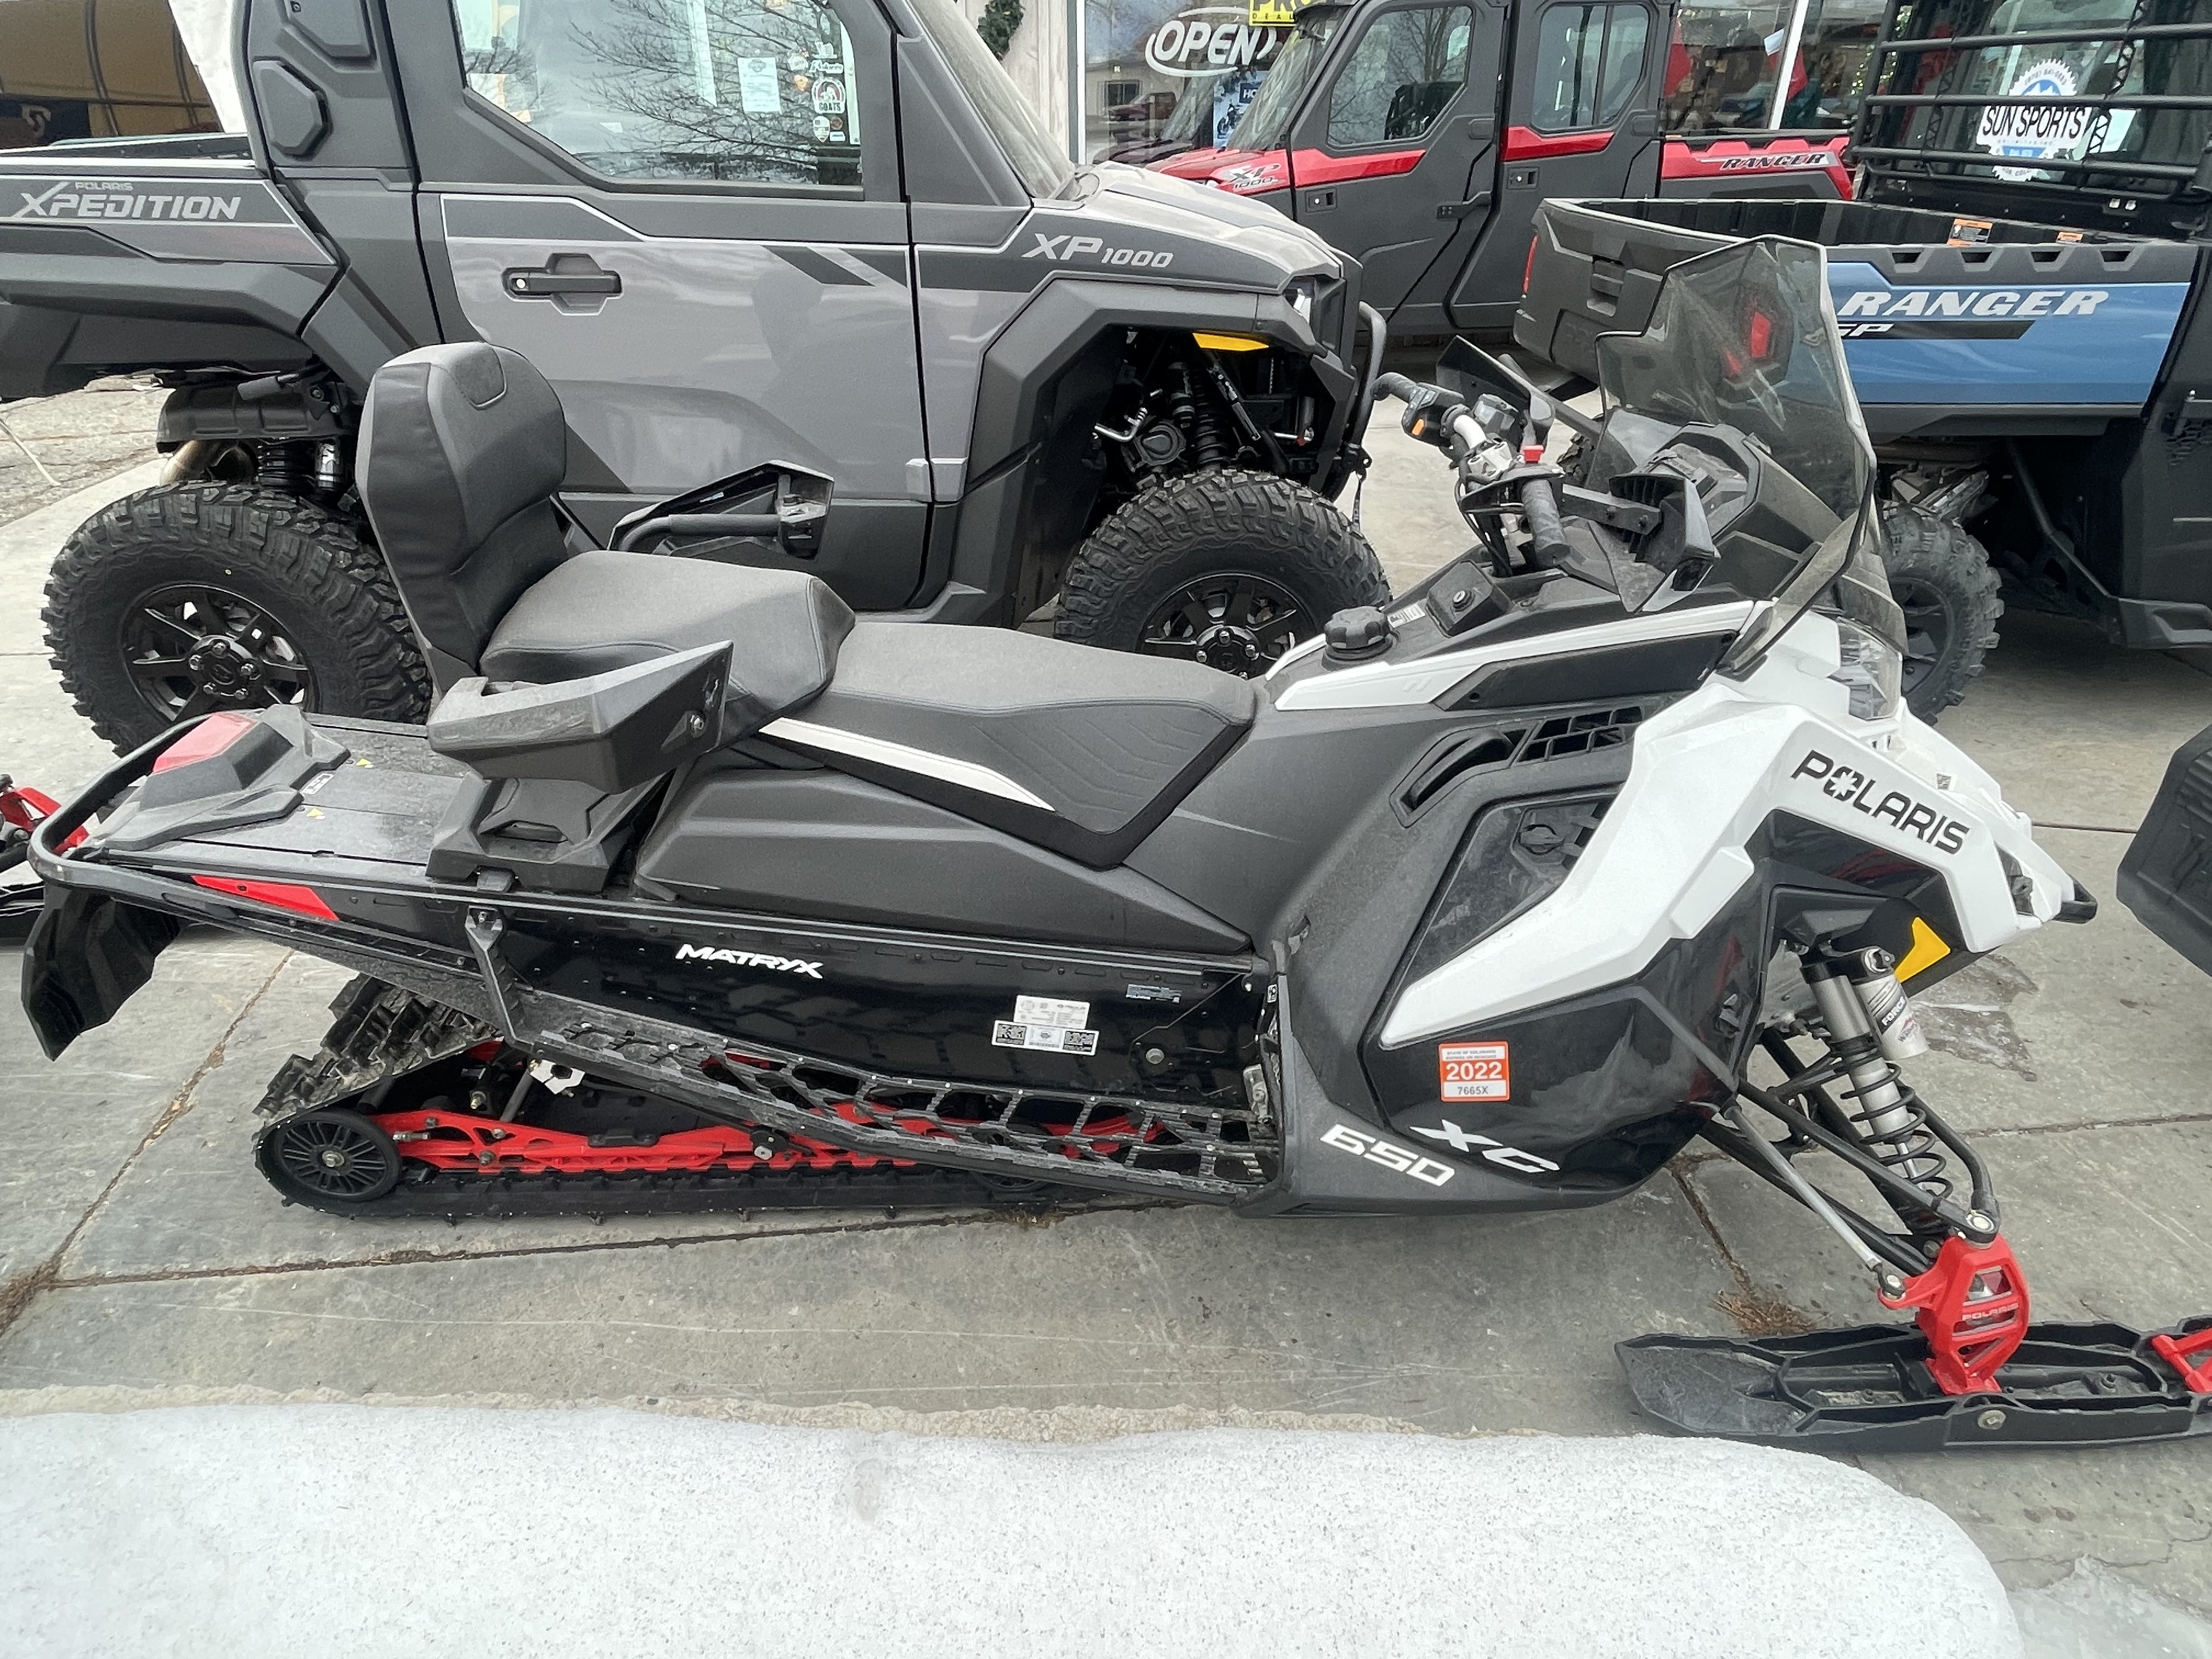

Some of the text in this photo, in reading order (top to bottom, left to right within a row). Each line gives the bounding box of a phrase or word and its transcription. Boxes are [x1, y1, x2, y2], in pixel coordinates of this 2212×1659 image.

[1154, 20, 1263, 66] OPEN
[1982, 105, 2085, 139] SUN SPORTS
[1229, 164, 1280, 182] XP
[1721, 153, 1826, 170] RANGER
[75, 182, 134, 191] POLARIS
[1234, 177, 1273, 189] 1000
[12, 182, 241, 219] XPEDITION
[1022, 233, 1174, 268] XP 1000
[1837, 291, 2109, 316] RANGER
[1791, 749, 1970, 855] POLARIS
[675, 944, 823, 979] MATRYX
[1446, 1061, 1502, 1080] 2022
[1457, 1086, 1488, 1095] 7665X
[1319, 1124, 1455, 1187] 650
[1409, 1119, 1561, 1173] XC
